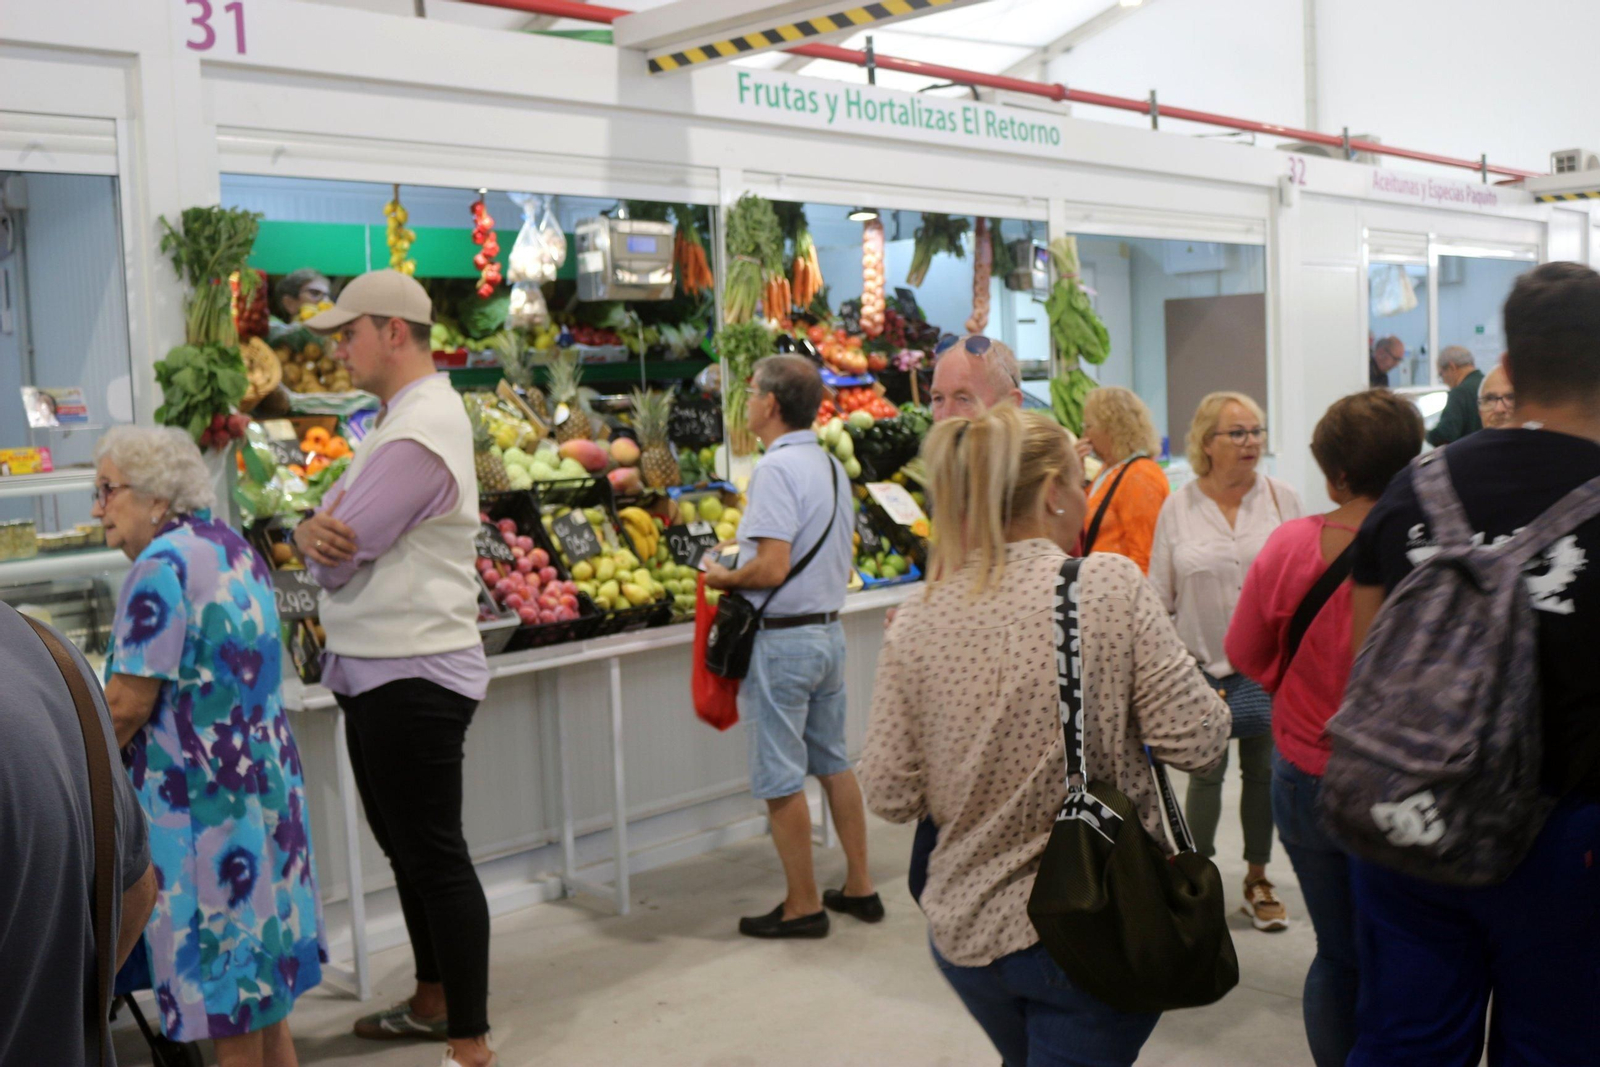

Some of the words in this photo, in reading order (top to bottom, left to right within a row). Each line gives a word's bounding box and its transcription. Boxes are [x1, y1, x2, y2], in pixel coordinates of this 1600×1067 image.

[186, 0, 247, 55] 31
[737, 71, 819, 116] Frutas
[824, 92, 839, 125] y
[846, 87, 957, 133] Hortalizas
[961, 106, 979, 135] El
[986, 110, 1061, 145] Retorno
[1288, 156, 1306, 186] 32
